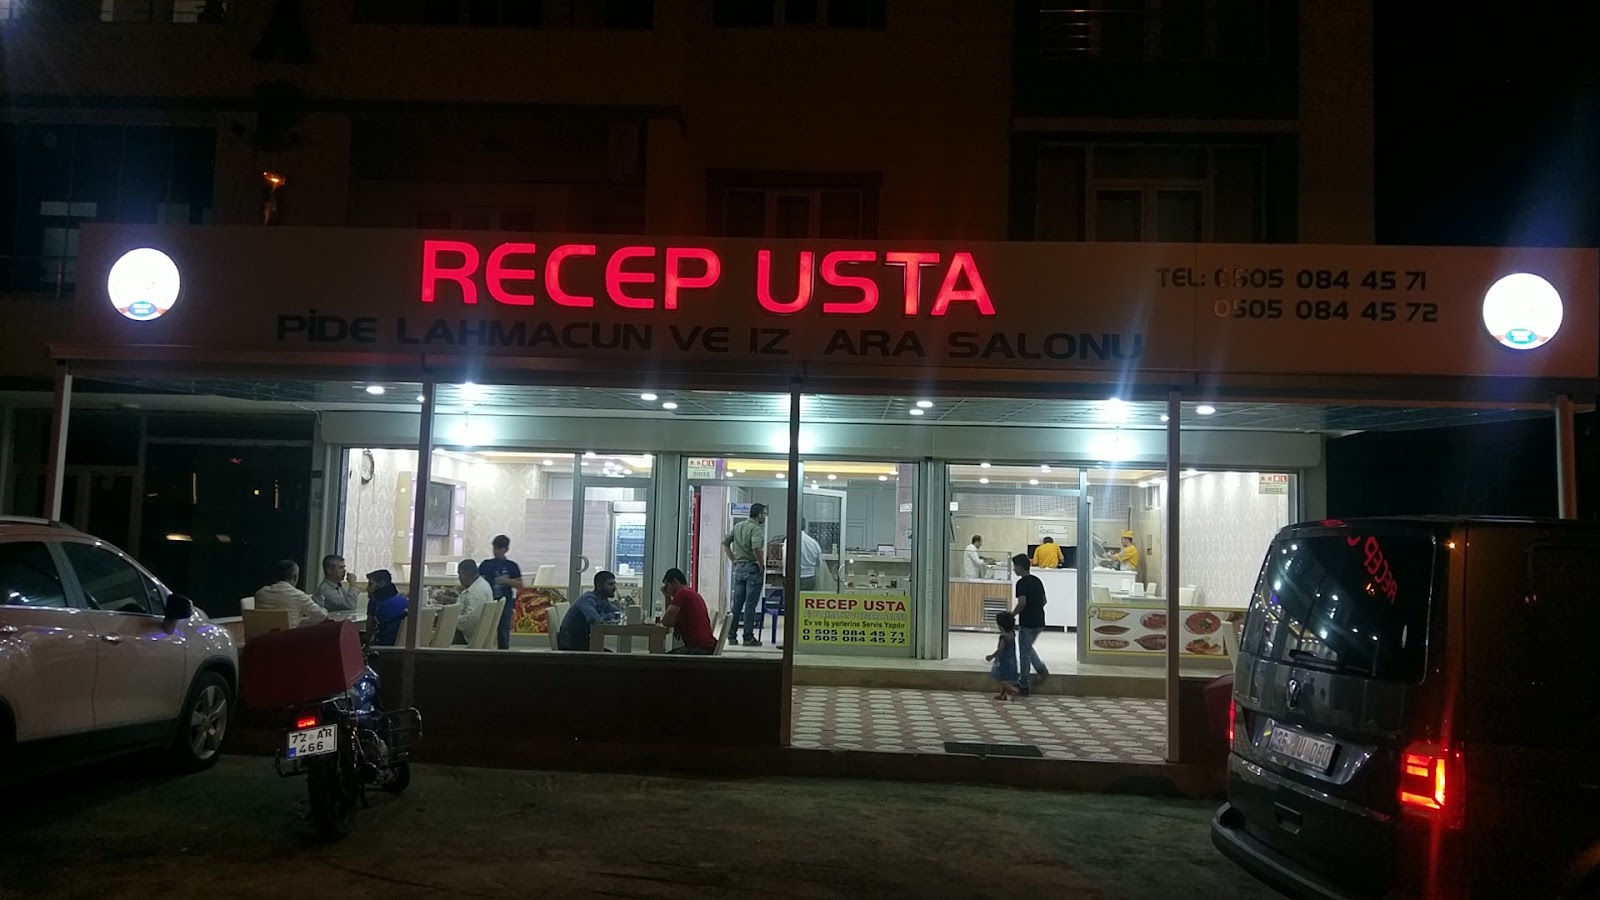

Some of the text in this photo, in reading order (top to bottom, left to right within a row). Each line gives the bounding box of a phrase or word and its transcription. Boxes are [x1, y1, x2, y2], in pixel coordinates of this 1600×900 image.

[420, 239, 997, 317] RECEP USTA
[1157, 268, 1427, 292] TEL: 0505 084 45 71
[1213, 298, 1439, 324] 0505 084 45 72
[277, 309, 377, 343] PİDE
[398, 317, 652, 351] LAHMACUN
[669, 326, 730, 352] VE
[949, 331, 1143, 361] SALONU
[804, 598, 907, 612] RECEP USTA
[861, 620, 883, 629] Servis
[292, 728, 332, 744] 72 AR
[299, 741, 324, 753] 466
